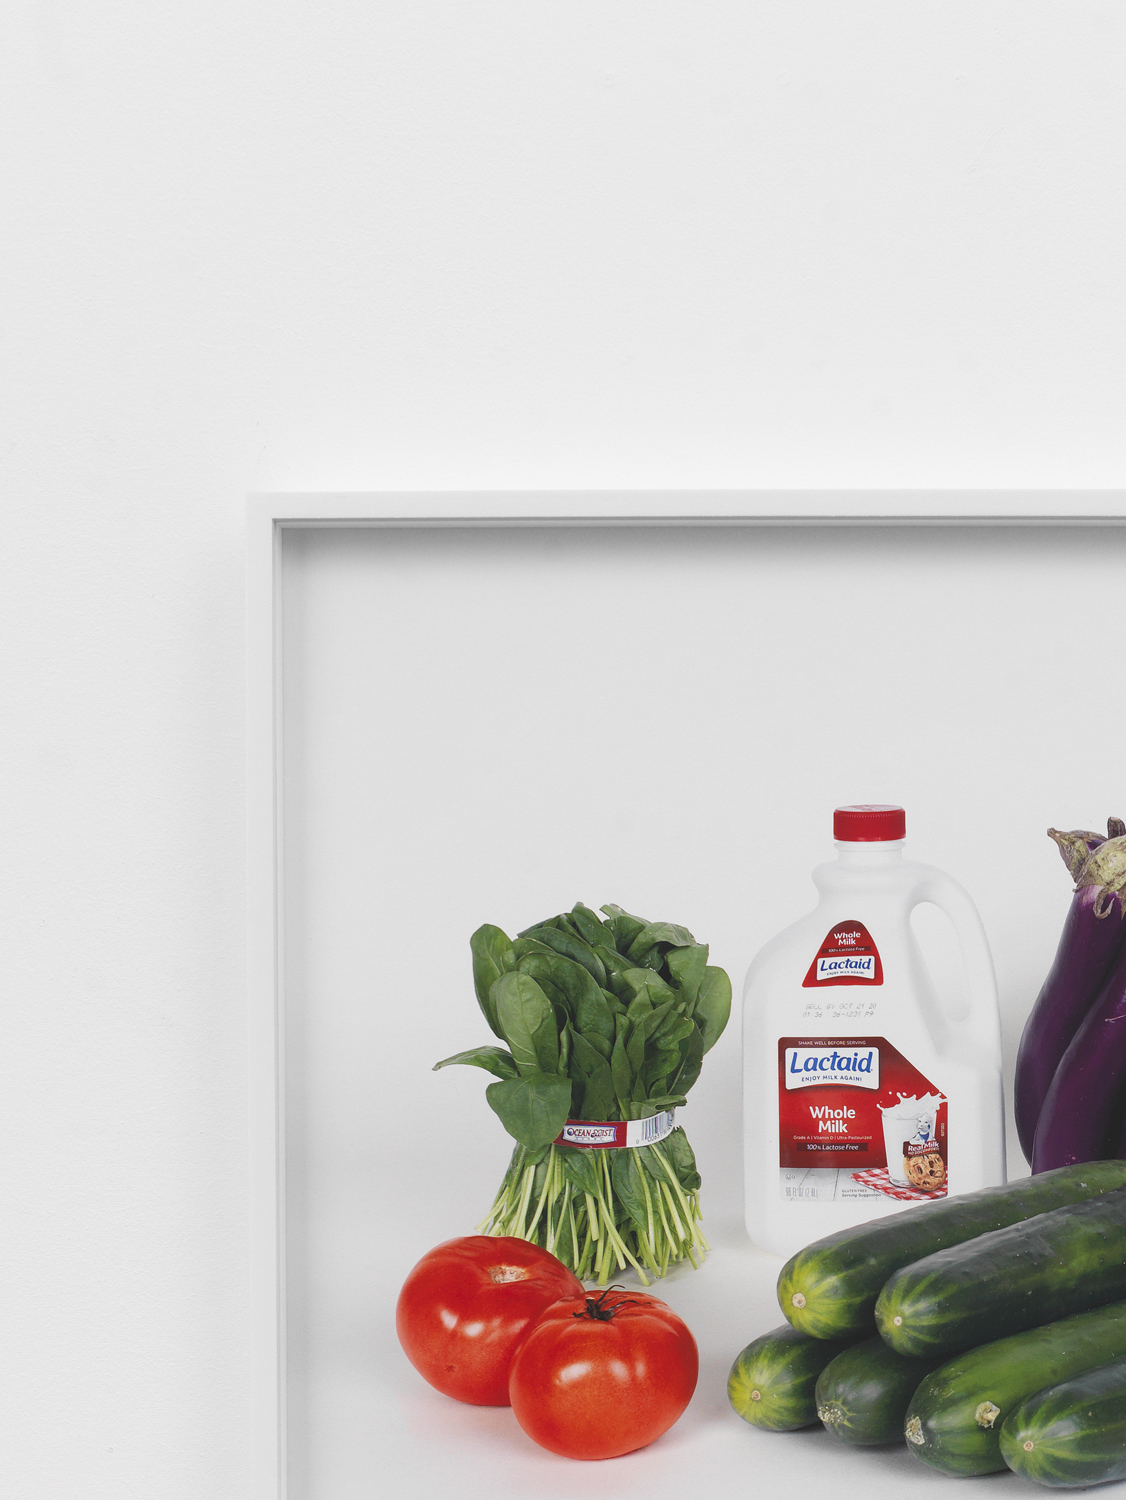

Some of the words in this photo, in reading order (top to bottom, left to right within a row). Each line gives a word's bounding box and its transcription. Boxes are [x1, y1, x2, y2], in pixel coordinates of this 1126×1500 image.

[834, 931, 861, 940] Whole
[820, 958, 872, 971] Lactaid
[790, 1052, 873, 1073] Lactaid
[810, 1106, 856, 1119] Whole
[567, 1128, 590, 1136] OCEAN
[818, 1120, 848, 1133] Milk
